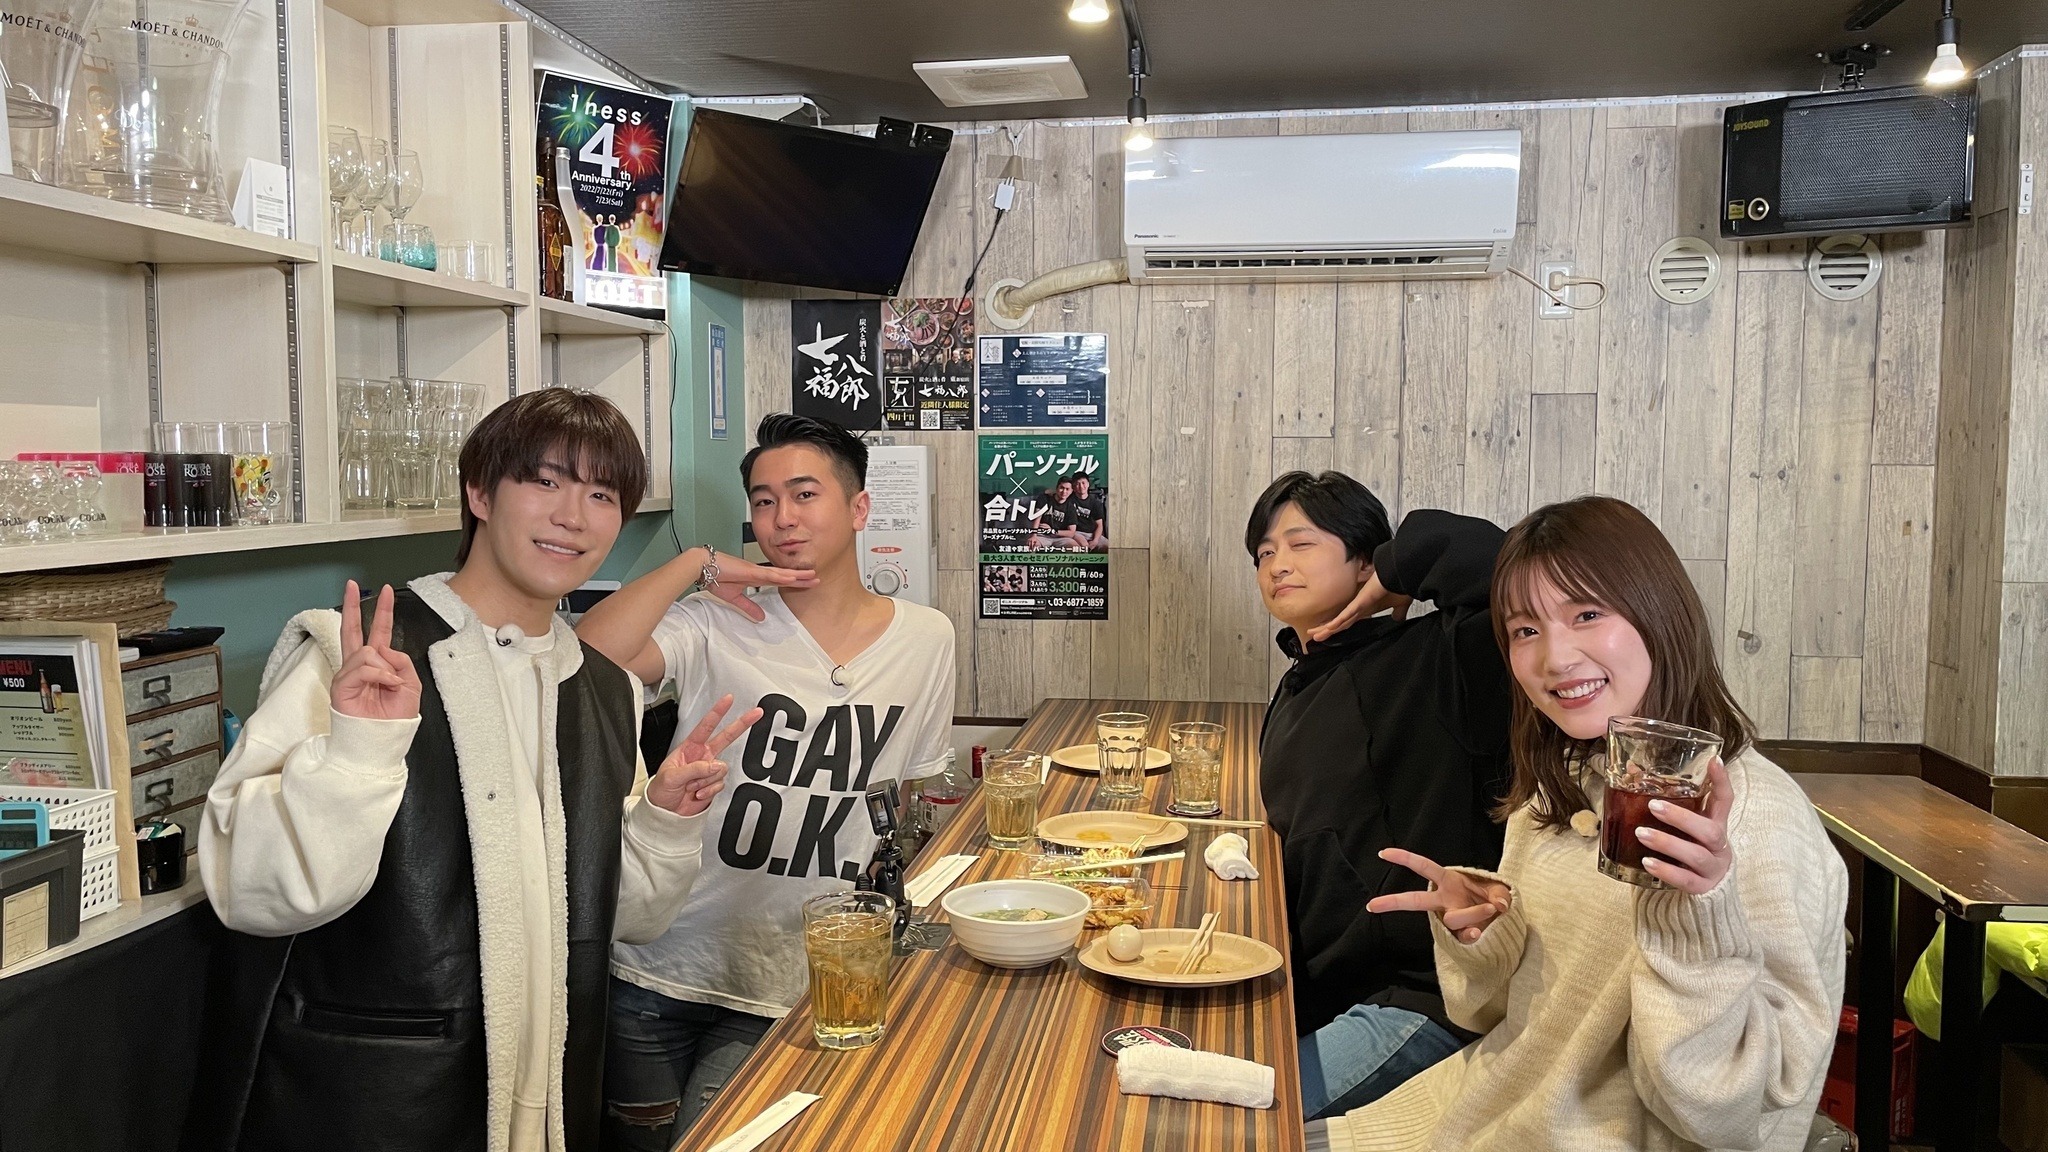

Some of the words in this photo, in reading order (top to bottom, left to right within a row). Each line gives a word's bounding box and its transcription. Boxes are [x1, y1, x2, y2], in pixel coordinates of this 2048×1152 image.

[44, 25, 51, 33] &
[130, 19, 170, 35] MOËT
[171, 27, 178, 37] &
[1732, 118, 1770, 132] JOYSOUND
[578, 122, 620, 178] 4
[620, 171, 631, 181] th
[985, 450, 1100, 476] パーソナル
[183, 469, 212, 478] ROSE
[983, 494, 1049, 521] 合トレ
[1053, 598, 1104, 607] 03-6877-1859
[2, 677, 25, 688] ¥500
[742, 693, 905, 792] GAY
[717, 782, 860, 882] O.K.
